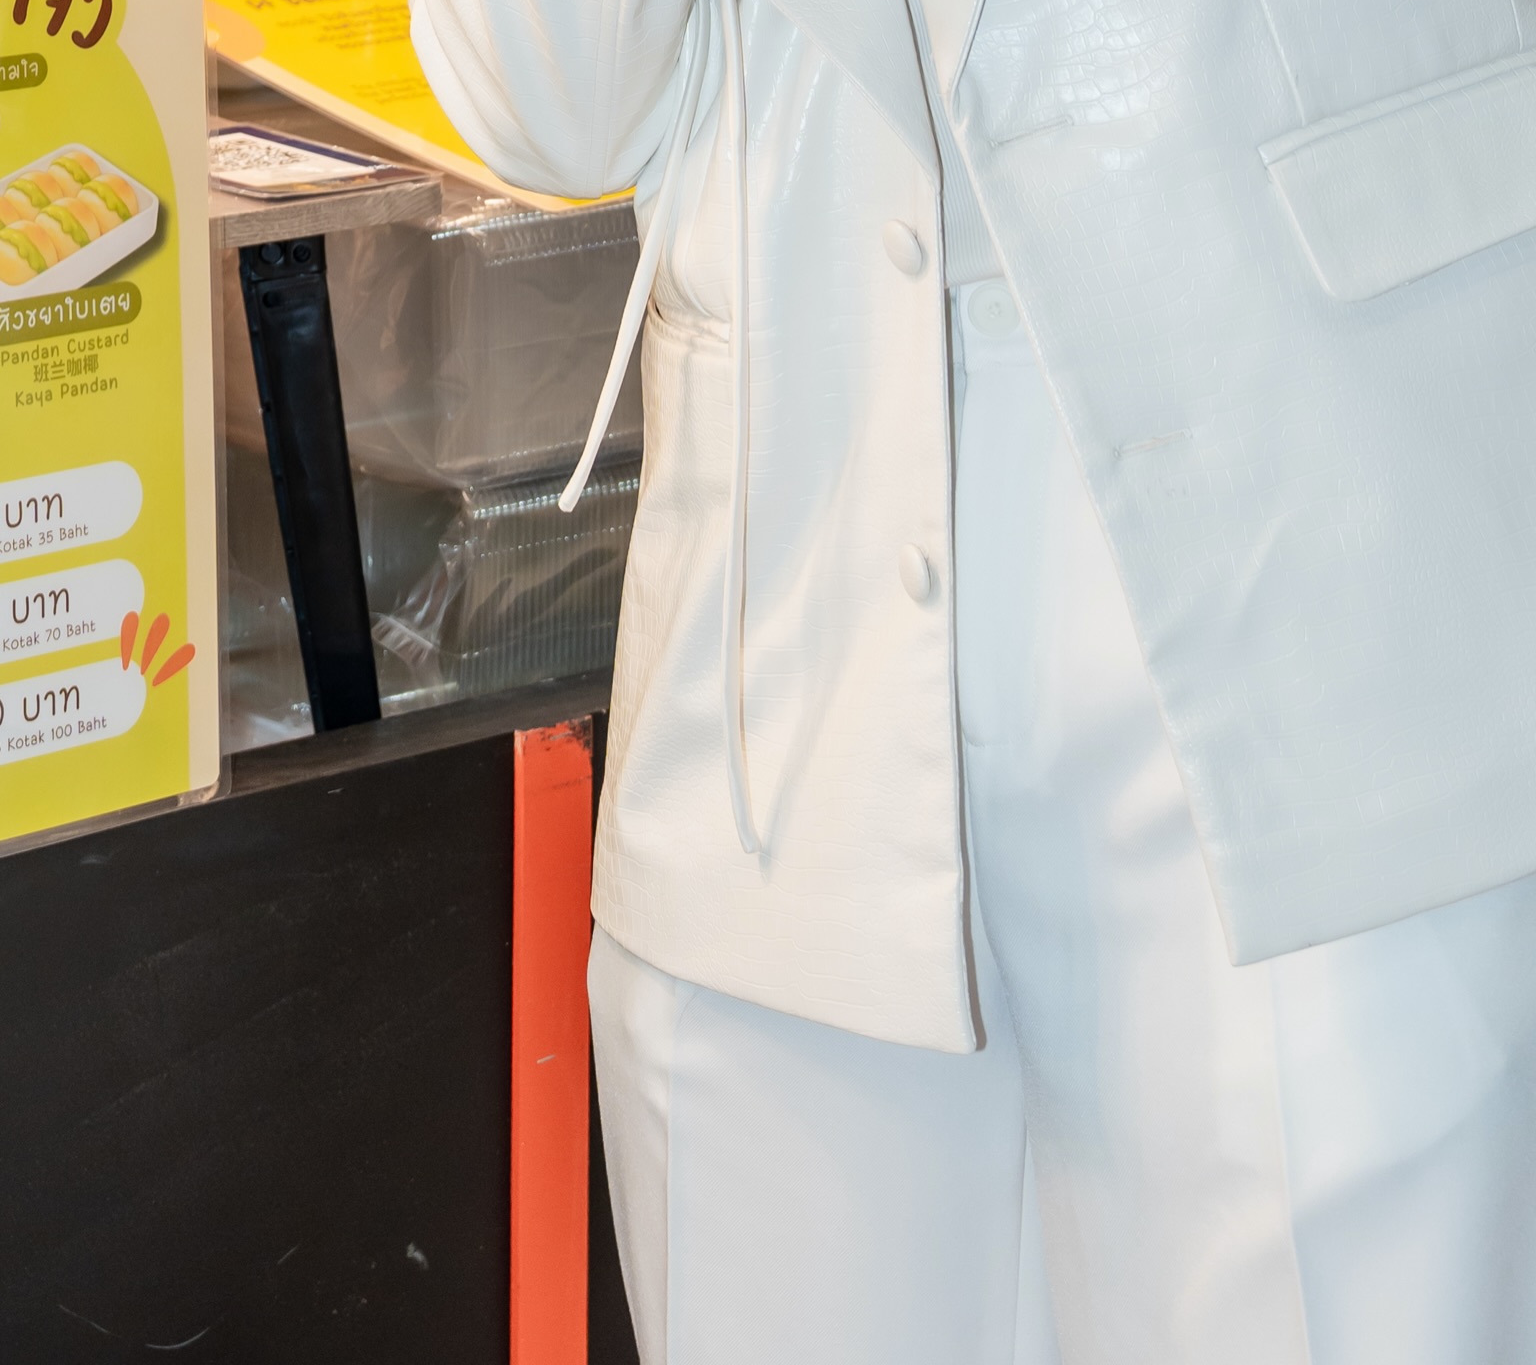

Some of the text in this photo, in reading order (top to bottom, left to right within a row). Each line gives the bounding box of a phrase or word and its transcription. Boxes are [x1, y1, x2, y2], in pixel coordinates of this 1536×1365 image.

[0, 328, 130, 366] Pandan Custard
[33, 354, 99, 383] 班兰咖椰
[15, 377, 119, 408] Kaya Pandan
[5, 492, 63, 529] บาท
[38, 530, 54, 545] 35
[59, 523, 89, 541] Baht
[12, 587, 70, 624] บาท
[2, 631, 40, 652] Kotak
[45, 627, 61, 643] 70
[66, 620, 96, 638] Baht
[23, 685, 80, 722] บาท
[7, 730, 45, 751] Kotak
[51, 723, 73, 740] 100
[78, 716, 107, 734] Baht
